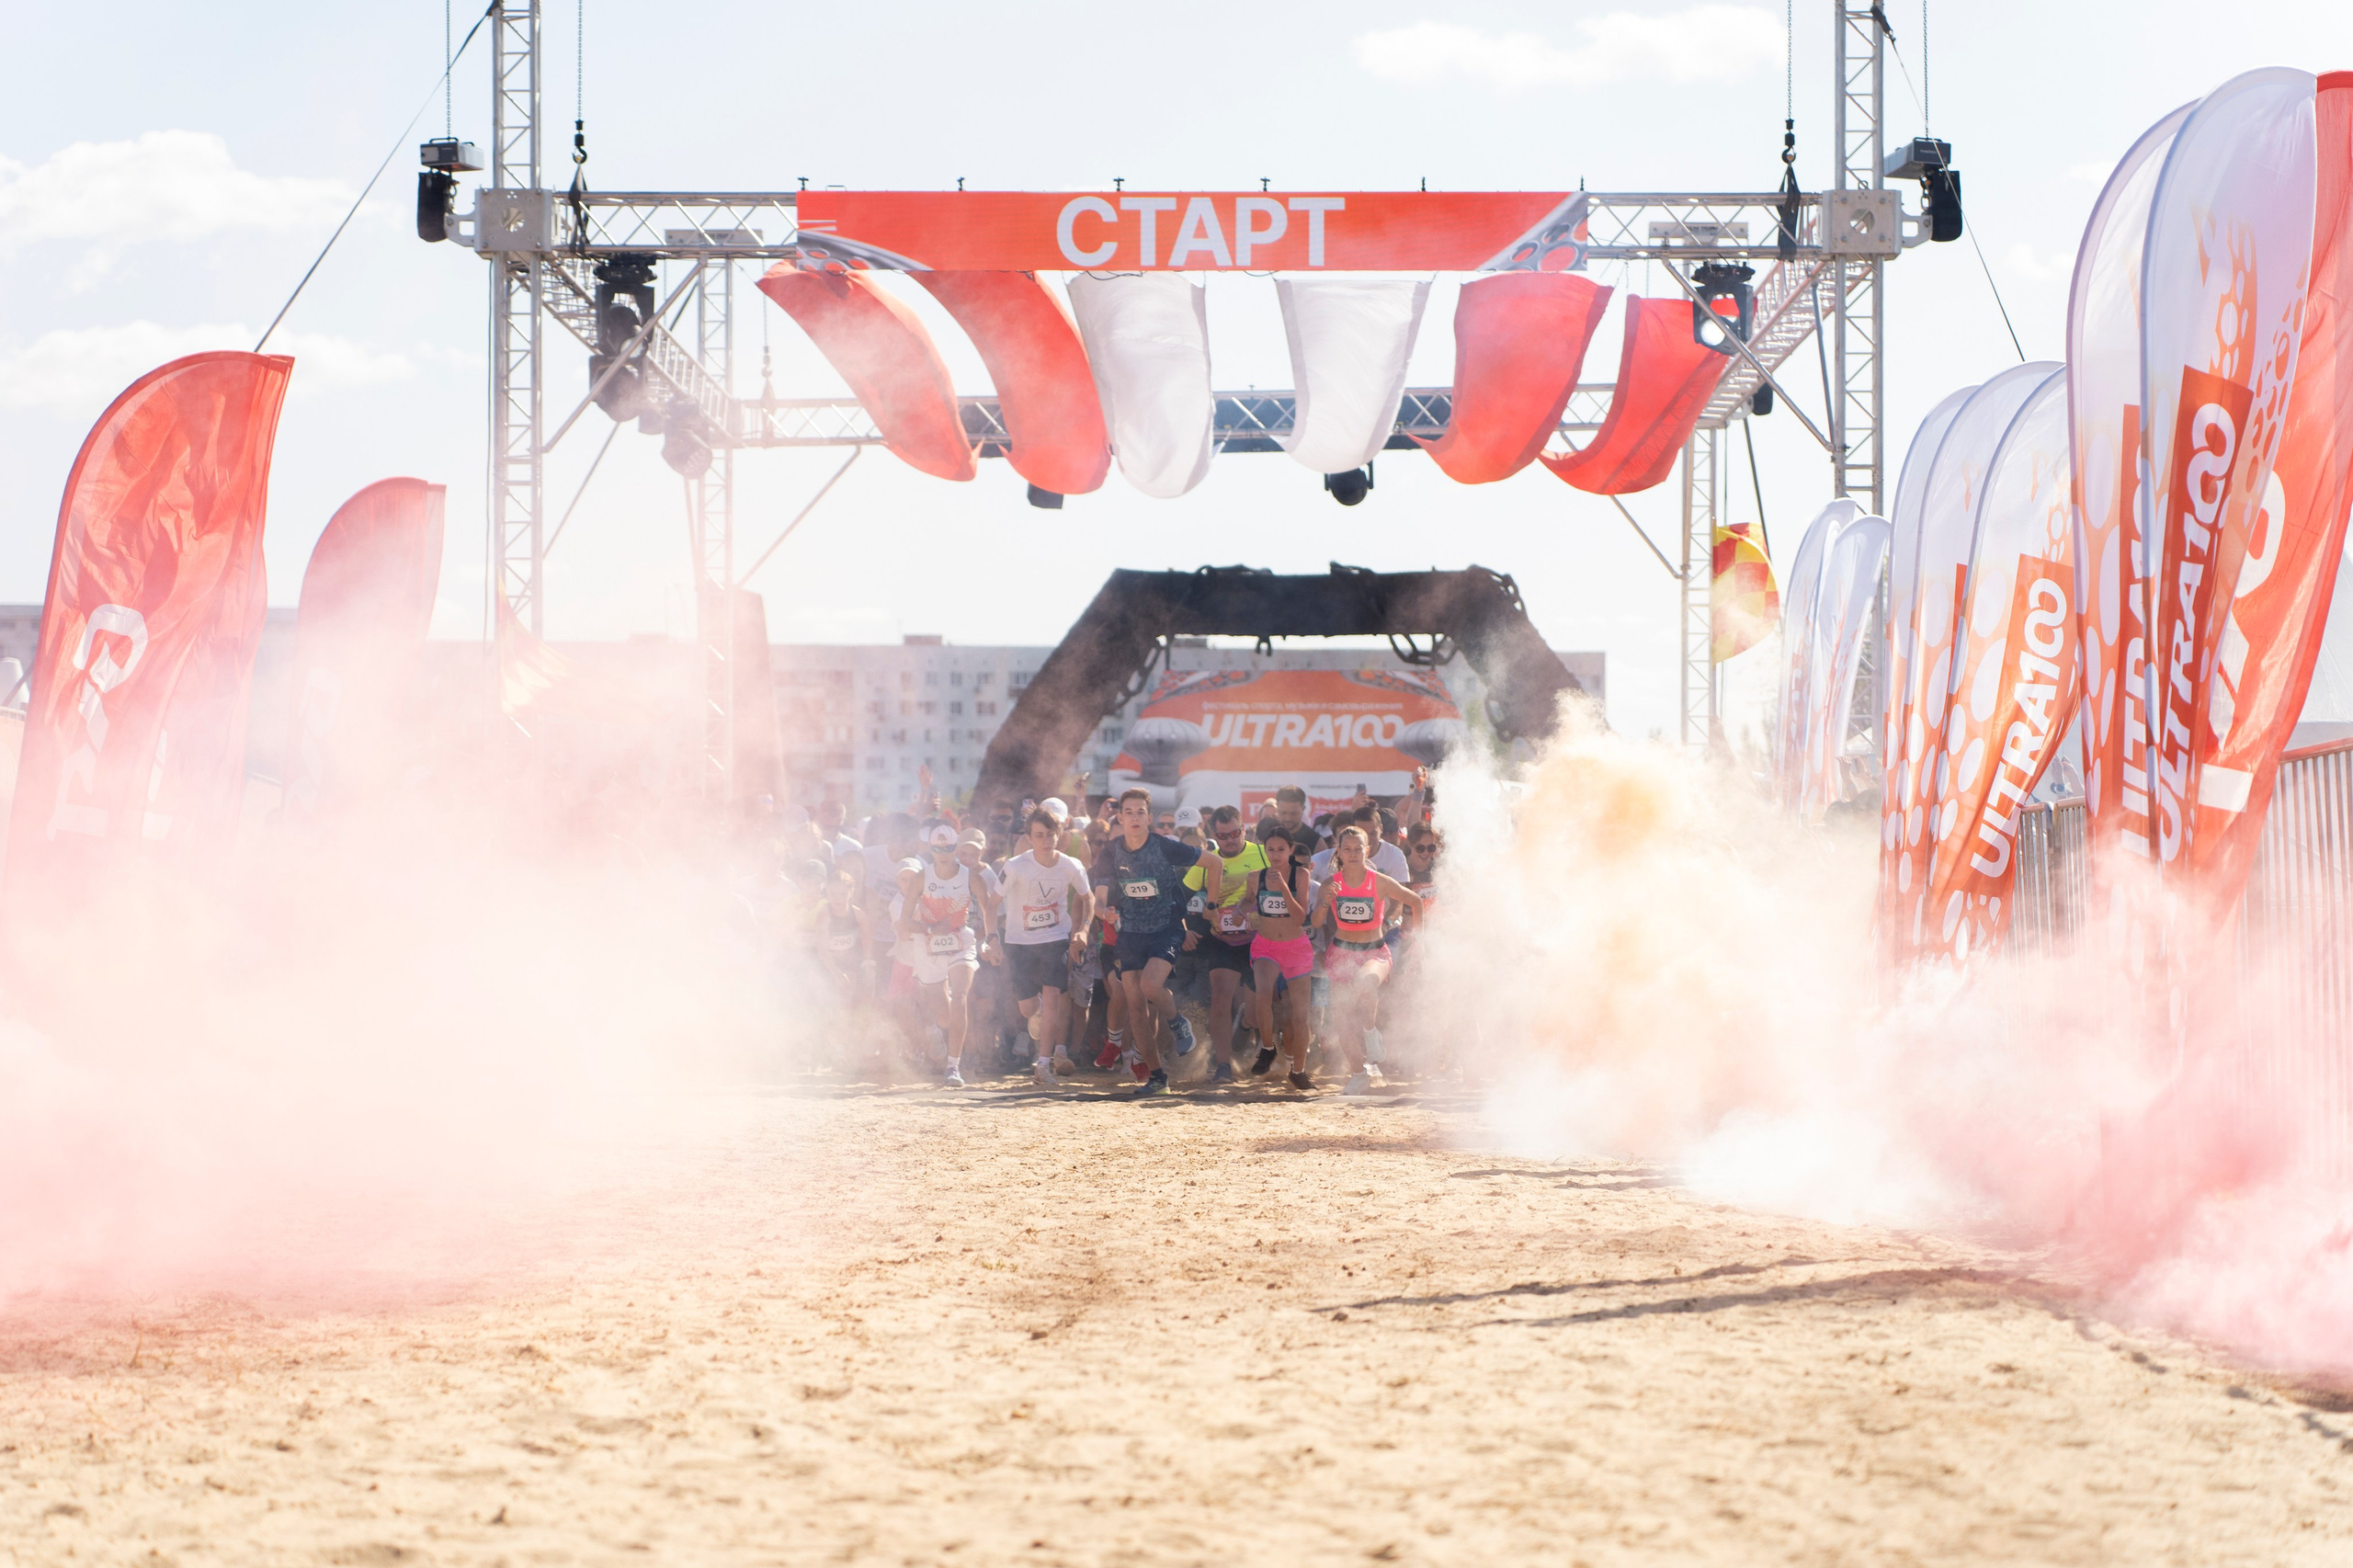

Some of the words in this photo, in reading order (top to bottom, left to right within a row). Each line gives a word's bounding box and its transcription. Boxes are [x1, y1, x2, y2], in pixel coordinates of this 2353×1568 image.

[1057, 196, 1345, 267] СТАРТ
[2158, 403, 2236, 862] ULTRA100
[1201, 714, 1405, 748] ULTRA100
[1971, 578, 2067, 877] ULTRA100
[1131, 885, 1148, 893] 219
[1268, 901, 1287, 909] 239
[1345, 905, 1365, 915] 229
[1031, 913, 1051, 923] 453
[1223, 917, 1233, 926] 53
[934, 937, 954, 947] 402
